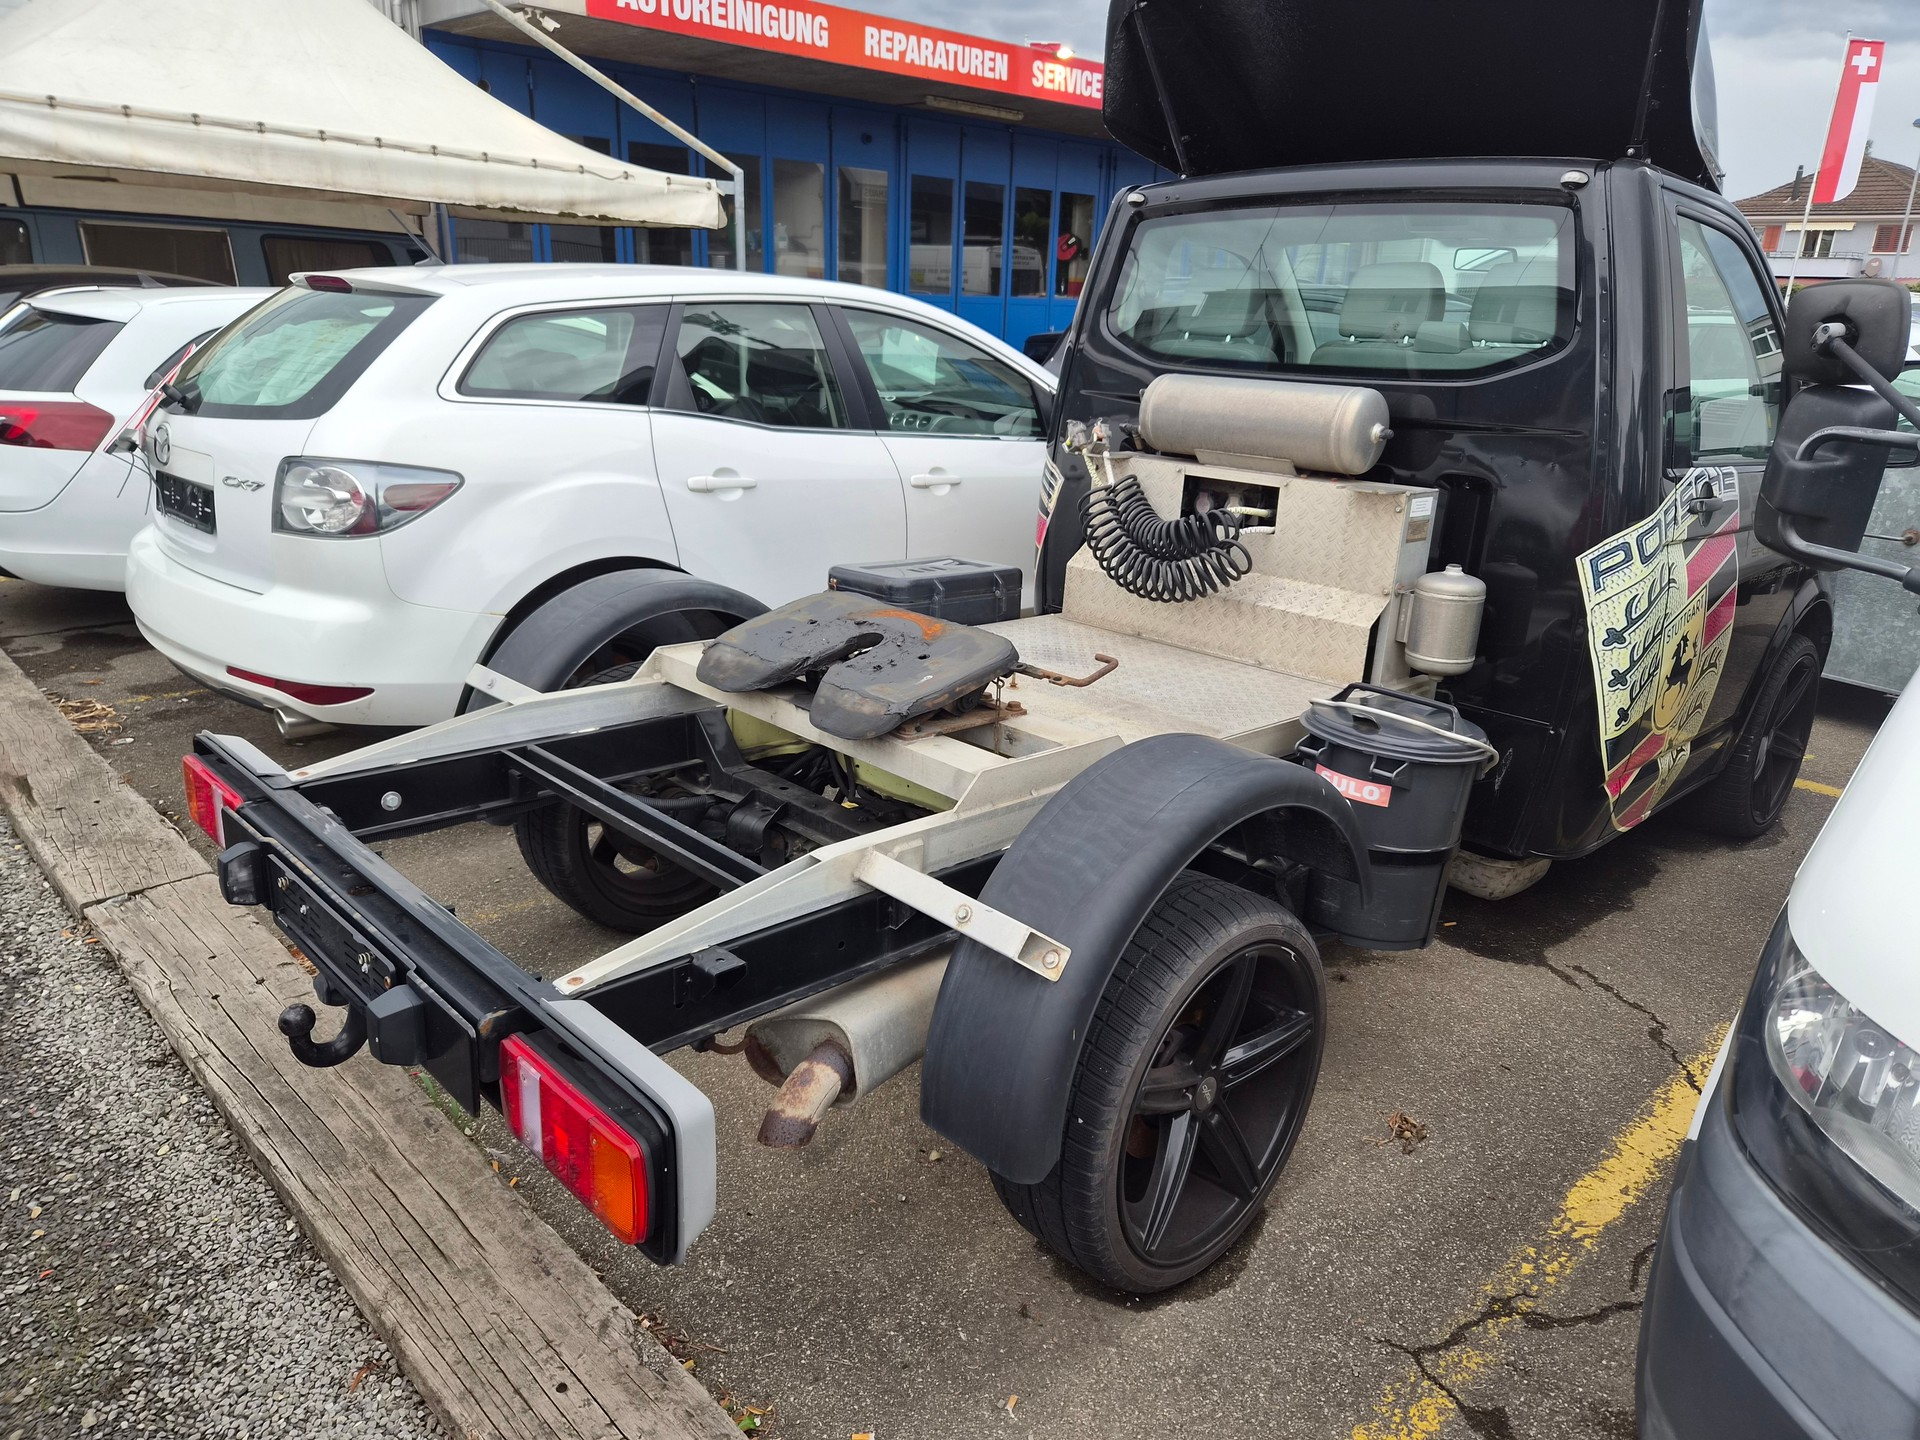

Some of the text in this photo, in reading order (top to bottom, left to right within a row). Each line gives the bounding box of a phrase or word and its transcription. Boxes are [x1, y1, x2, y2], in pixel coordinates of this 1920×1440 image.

[616, 0, 1103, 99] OREINIGUNG REPARATUREN SERVICE
[222, 476, 266, 492] CX-7
[1665, 593, 1704, 644] STUTTGART
